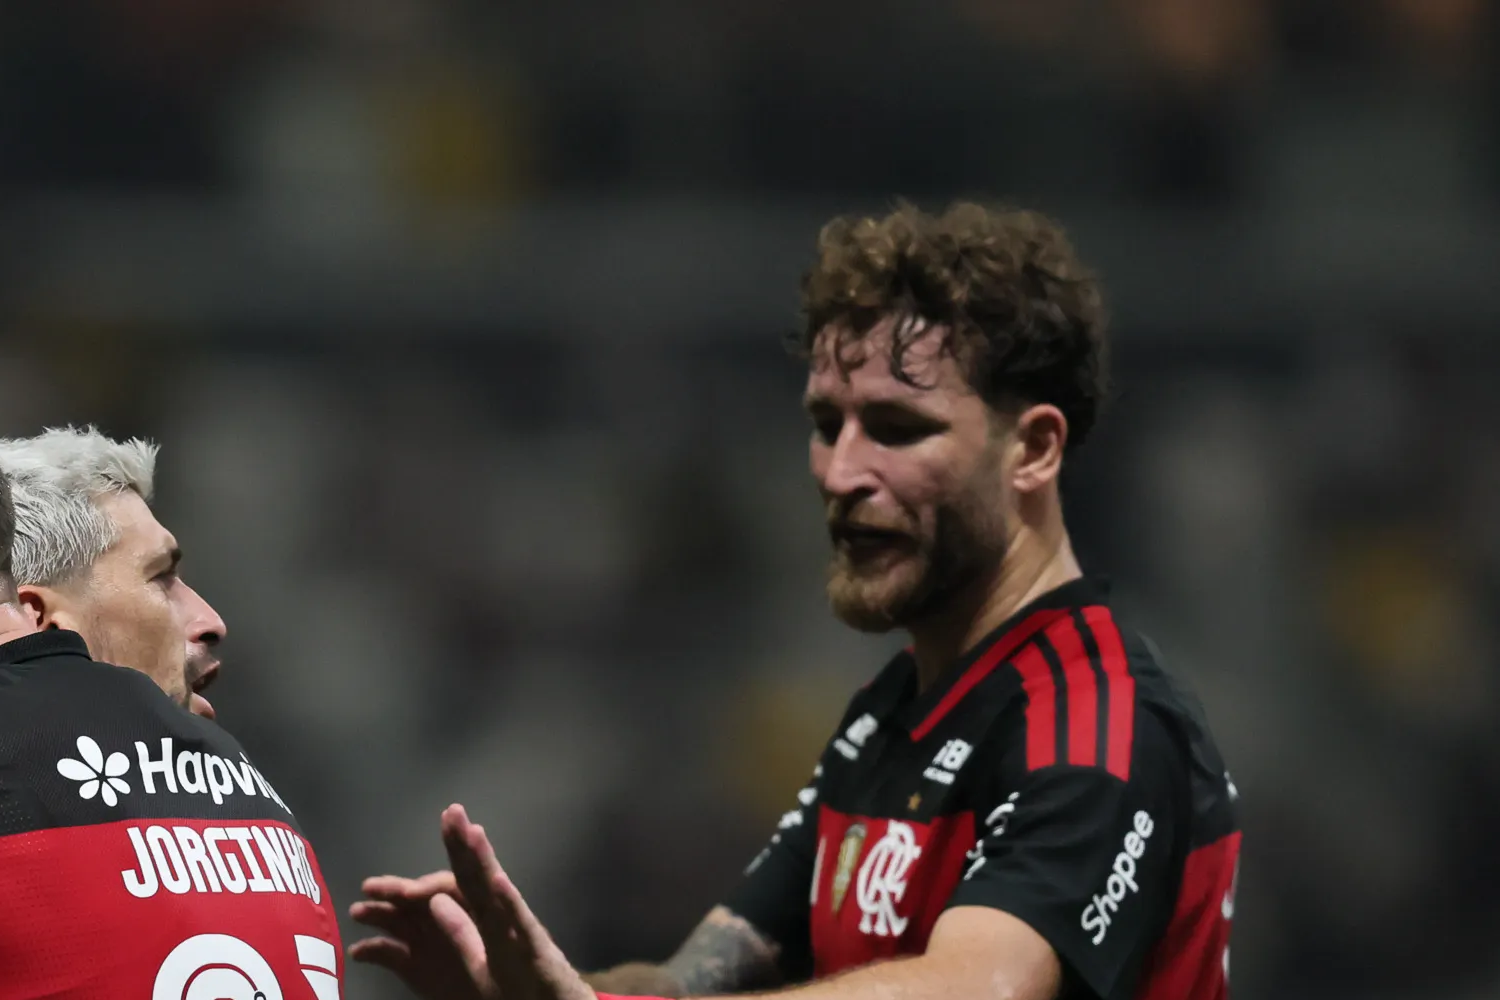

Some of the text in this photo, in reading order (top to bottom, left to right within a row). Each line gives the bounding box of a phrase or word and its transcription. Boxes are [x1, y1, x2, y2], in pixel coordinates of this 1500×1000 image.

[134, 737, 293, 815] Hapvi
[121, 825, 321, 905] JORGINHO
[1080, 808, 1156, 945] Shopee
